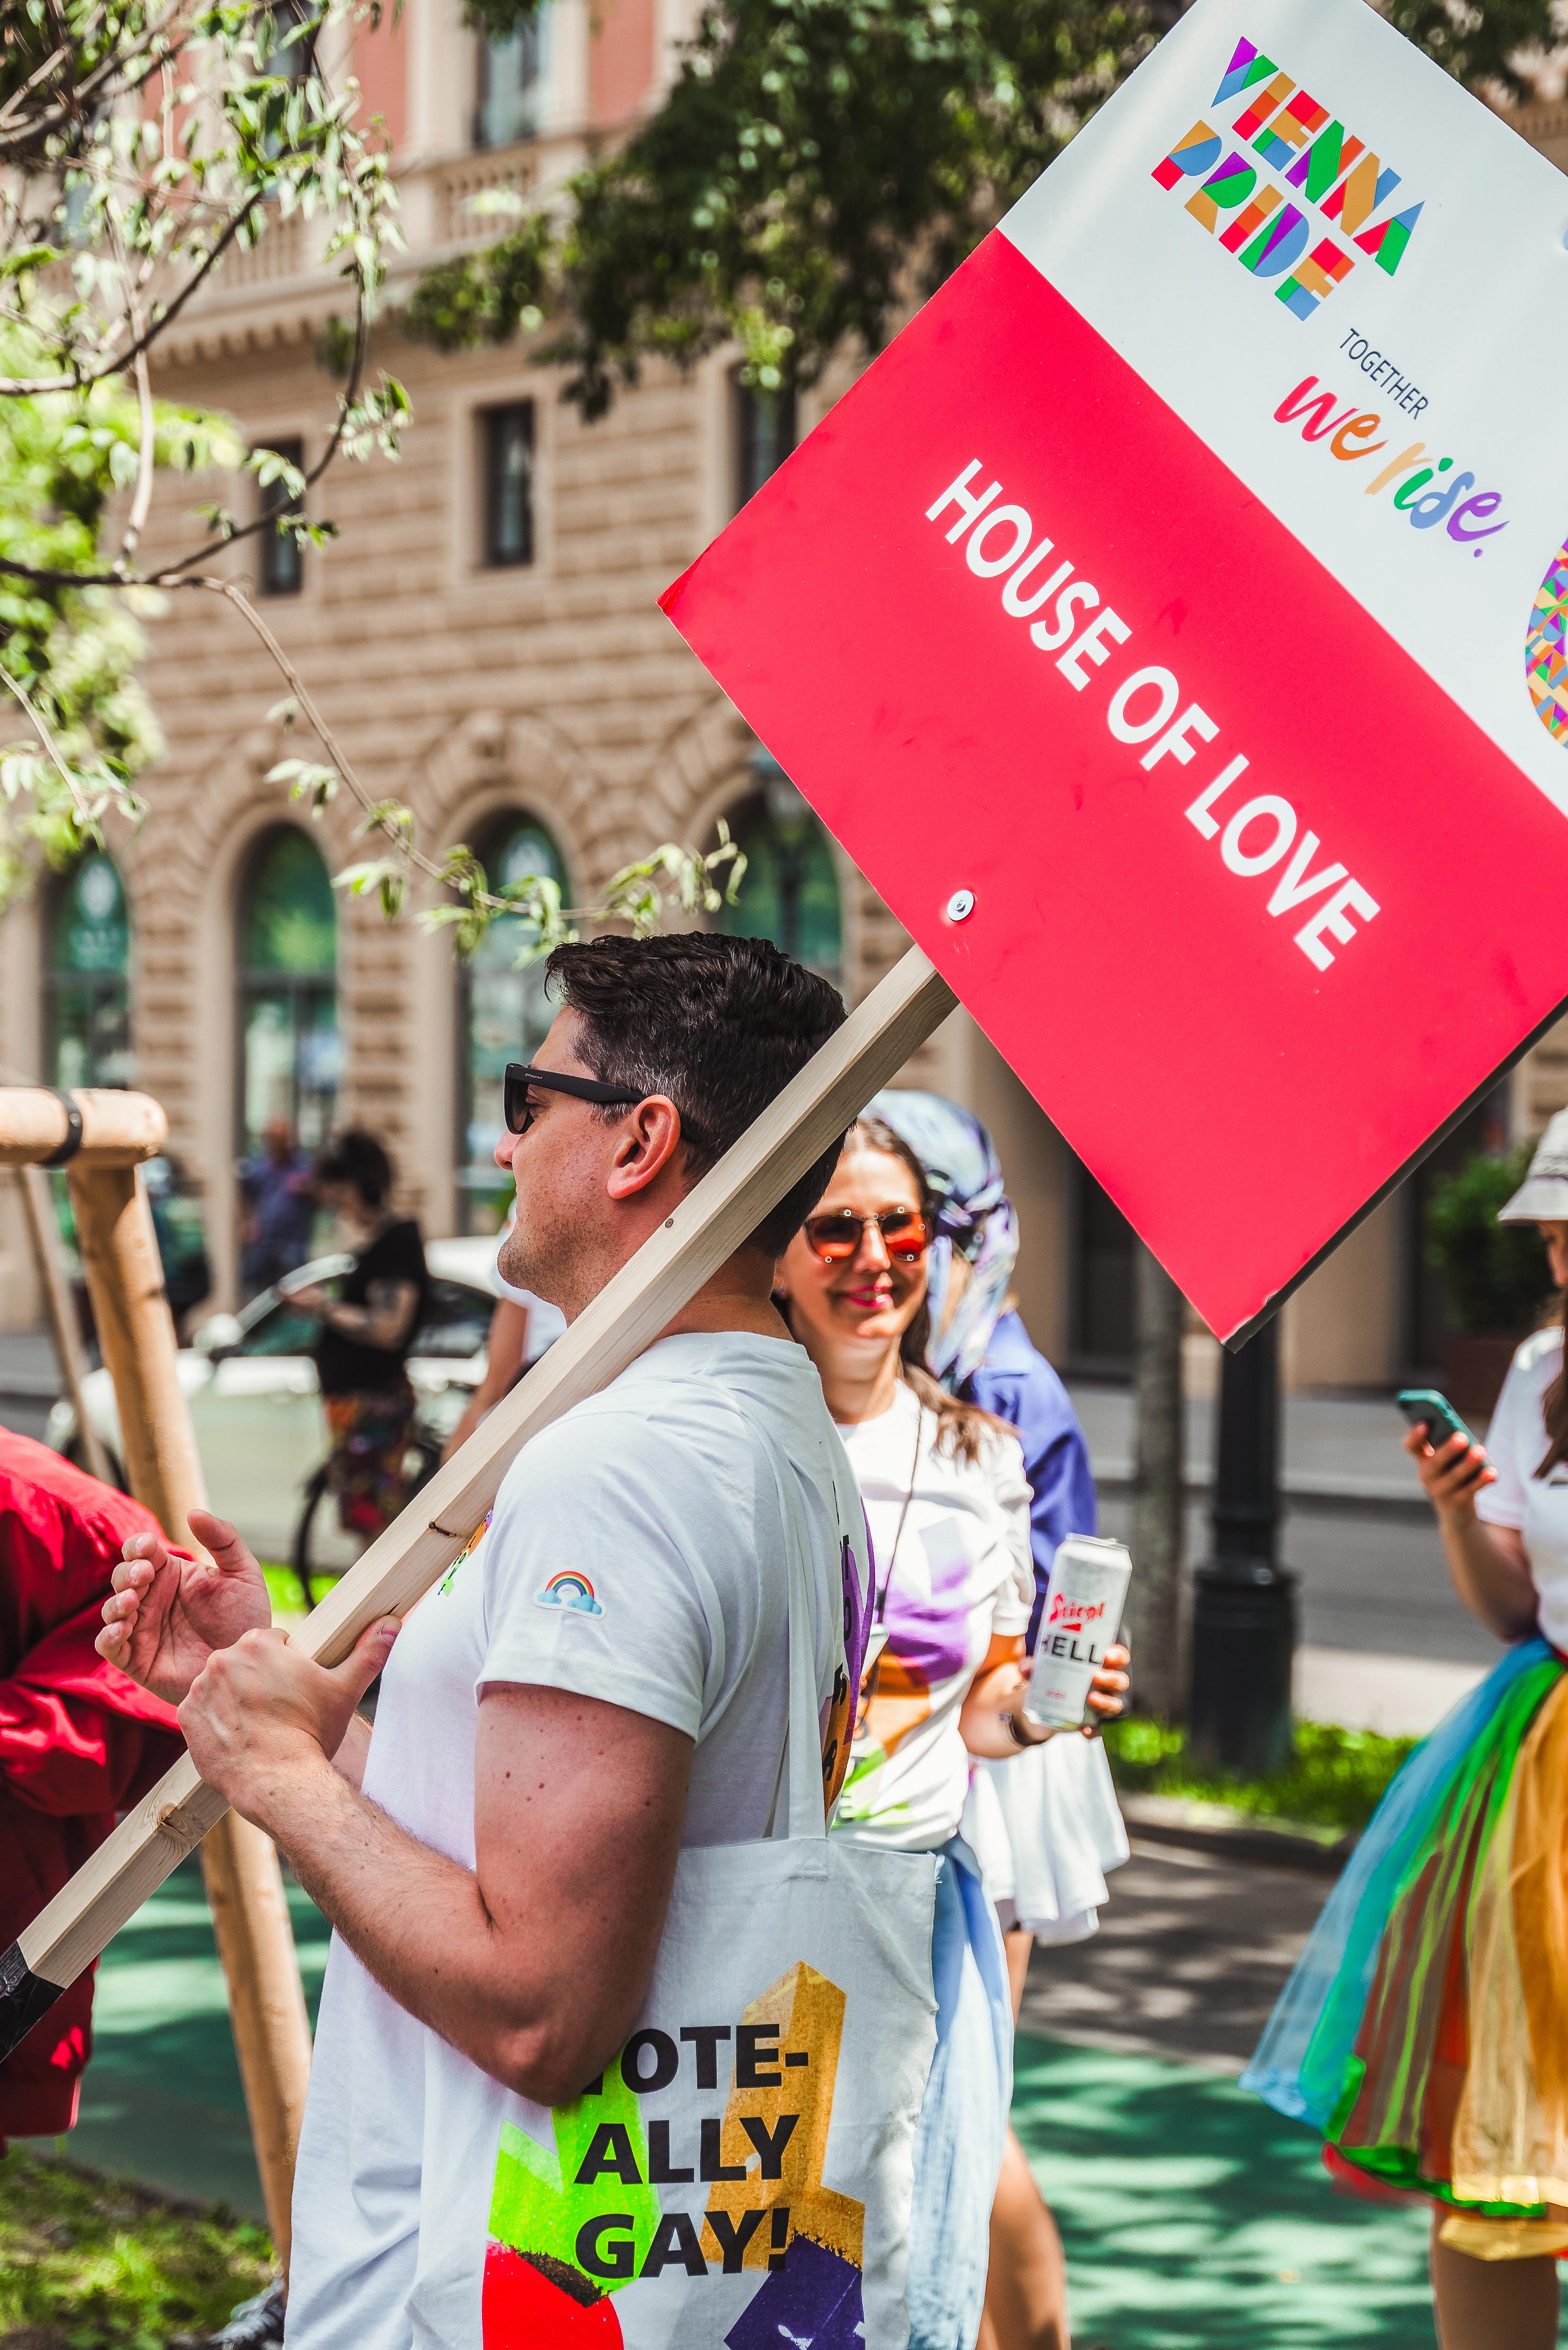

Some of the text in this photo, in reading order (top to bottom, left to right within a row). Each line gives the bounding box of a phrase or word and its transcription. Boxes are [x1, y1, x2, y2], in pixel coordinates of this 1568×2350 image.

[1151, 120, 1356, 322] PRIDE
[1211, 36, 1425, 277] VIENNA
[1339, 327, 1429, 420] TOGETHER
[1273, 375, 1510, 558] we rise.
[925, 457, 1381, 972] HOUSE OF LOVE
[581, 2023, 809, 2096] OTE-
[574, 2114, 800, 2185] ALLY
[575, 2207, 791, 2279] GAY!
